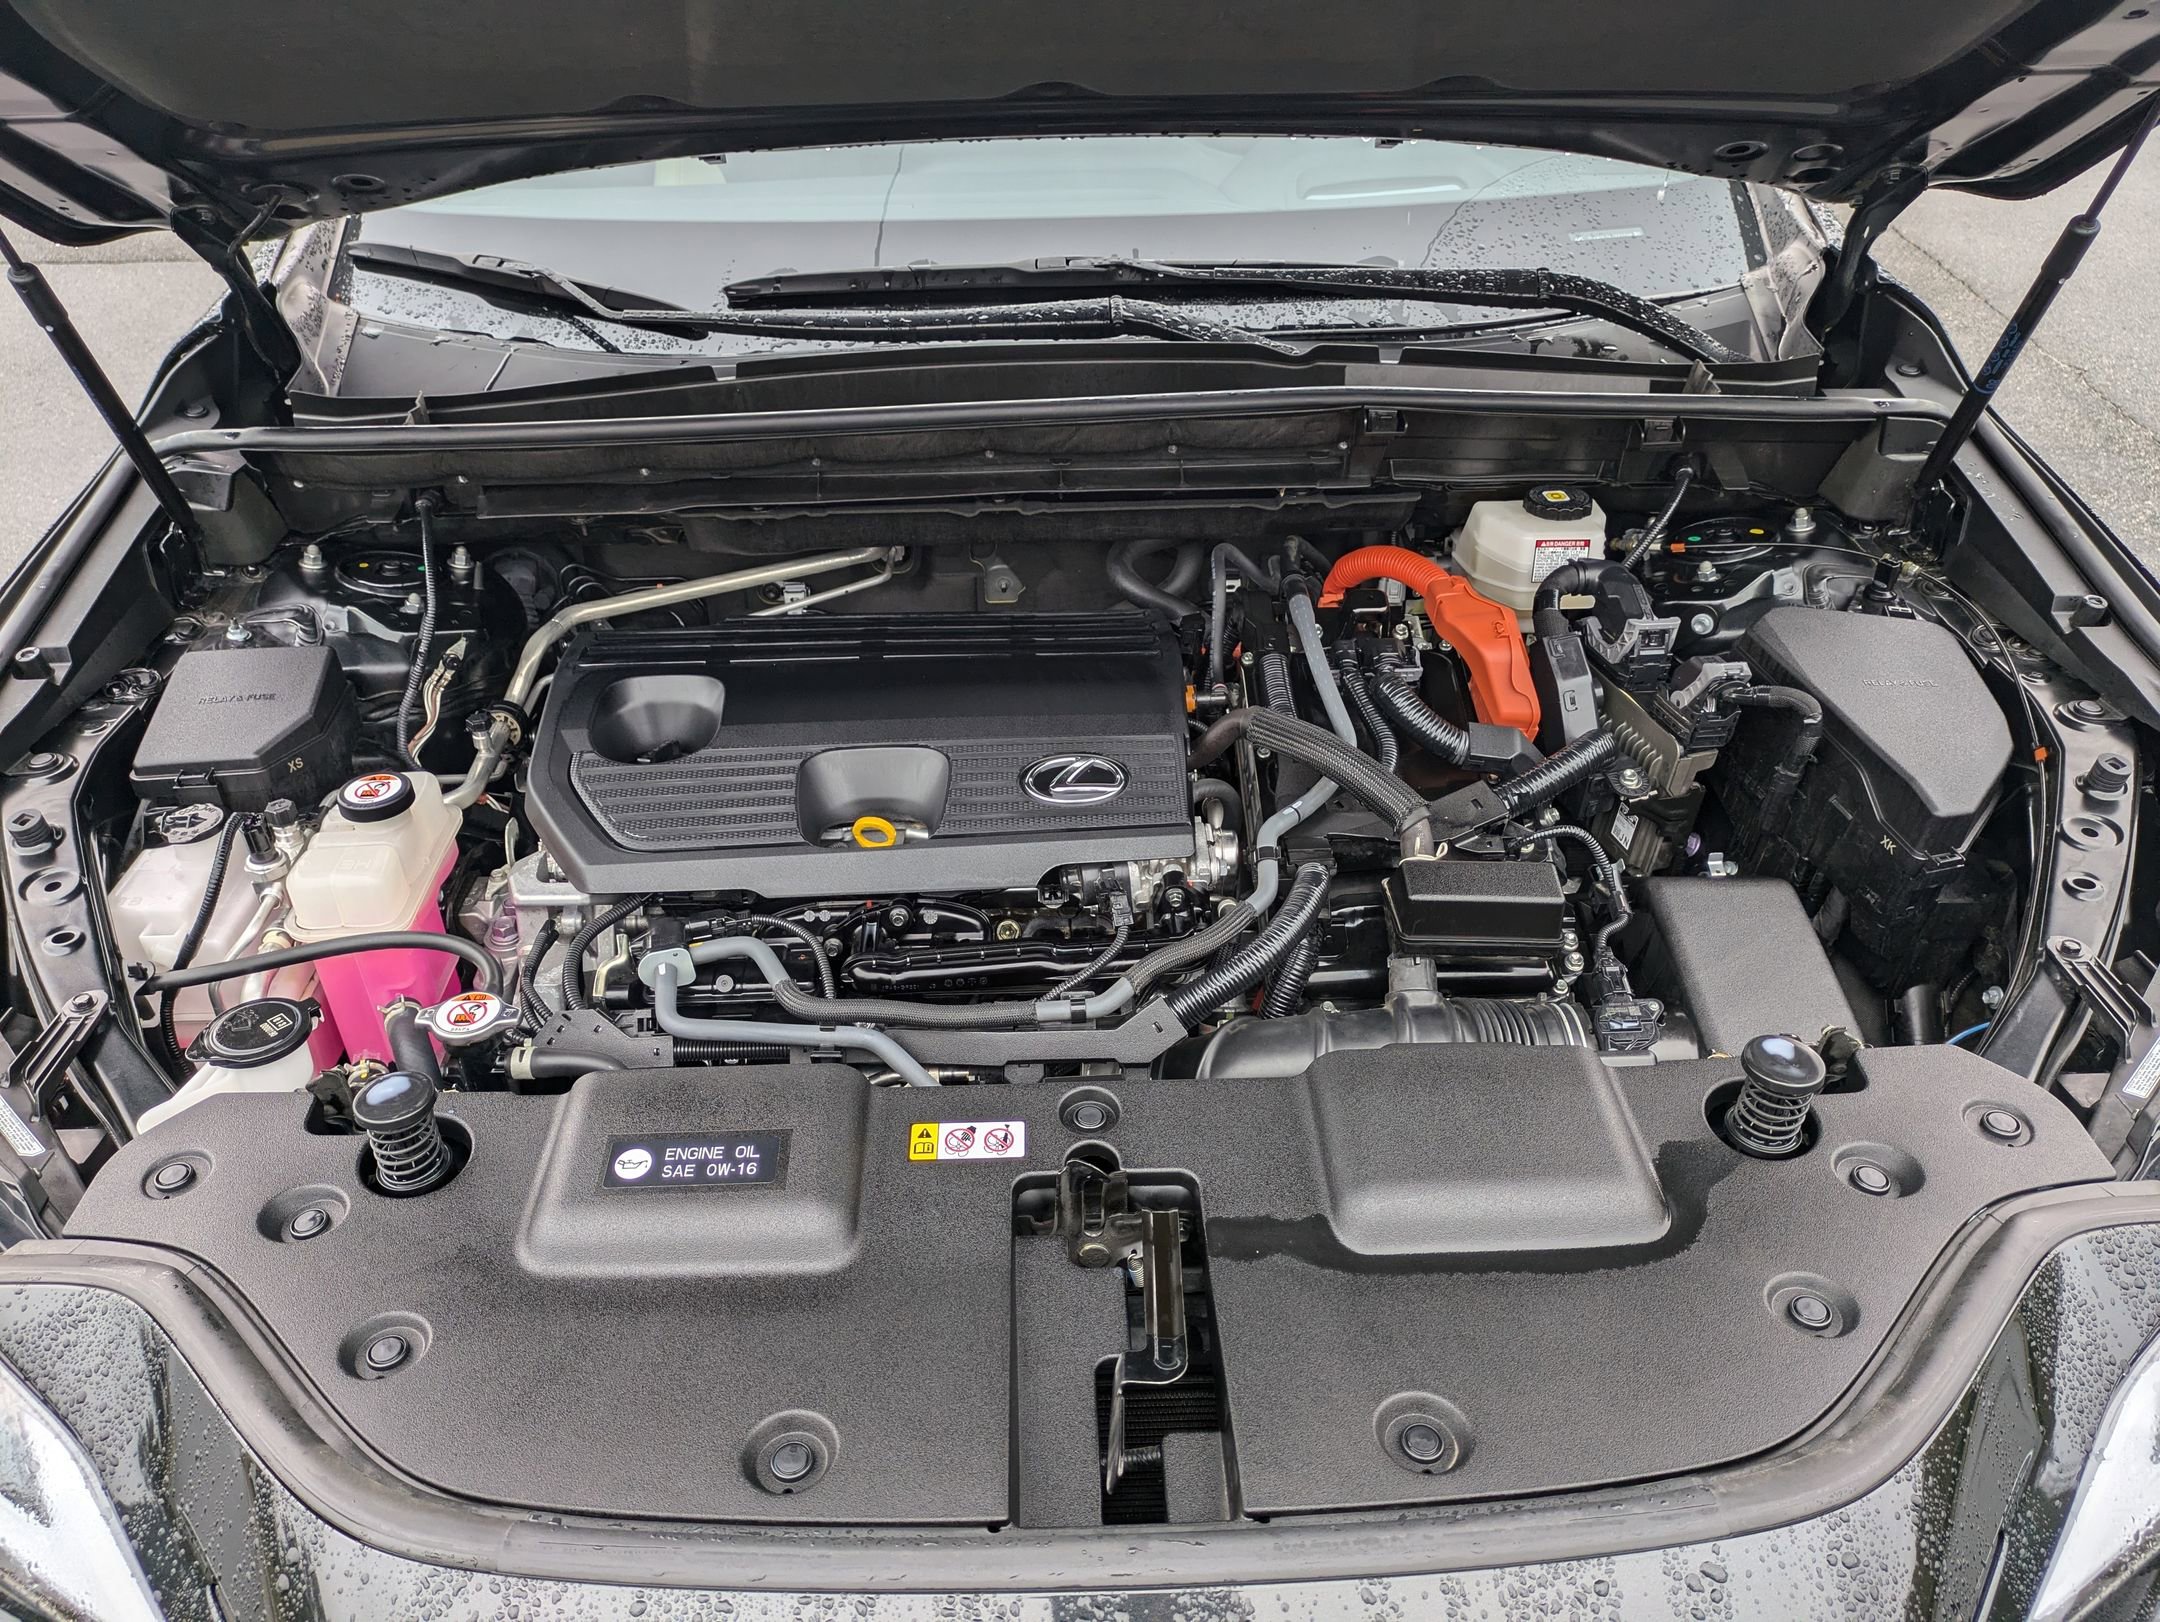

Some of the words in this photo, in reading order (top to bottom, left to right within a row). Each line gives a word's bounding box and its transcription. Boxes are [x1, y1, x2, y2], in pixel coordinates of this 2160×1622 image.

[287, 757, 304, 774] XS
[1880, 834, 1897, 856] XK
[664, 1146, 725, 1161] ENGINE
[735, 1145, 760, 1159] OIL
[661, 1164, 696, 1178] SAE
[706, 1162, 758, 1177] 0W-16
